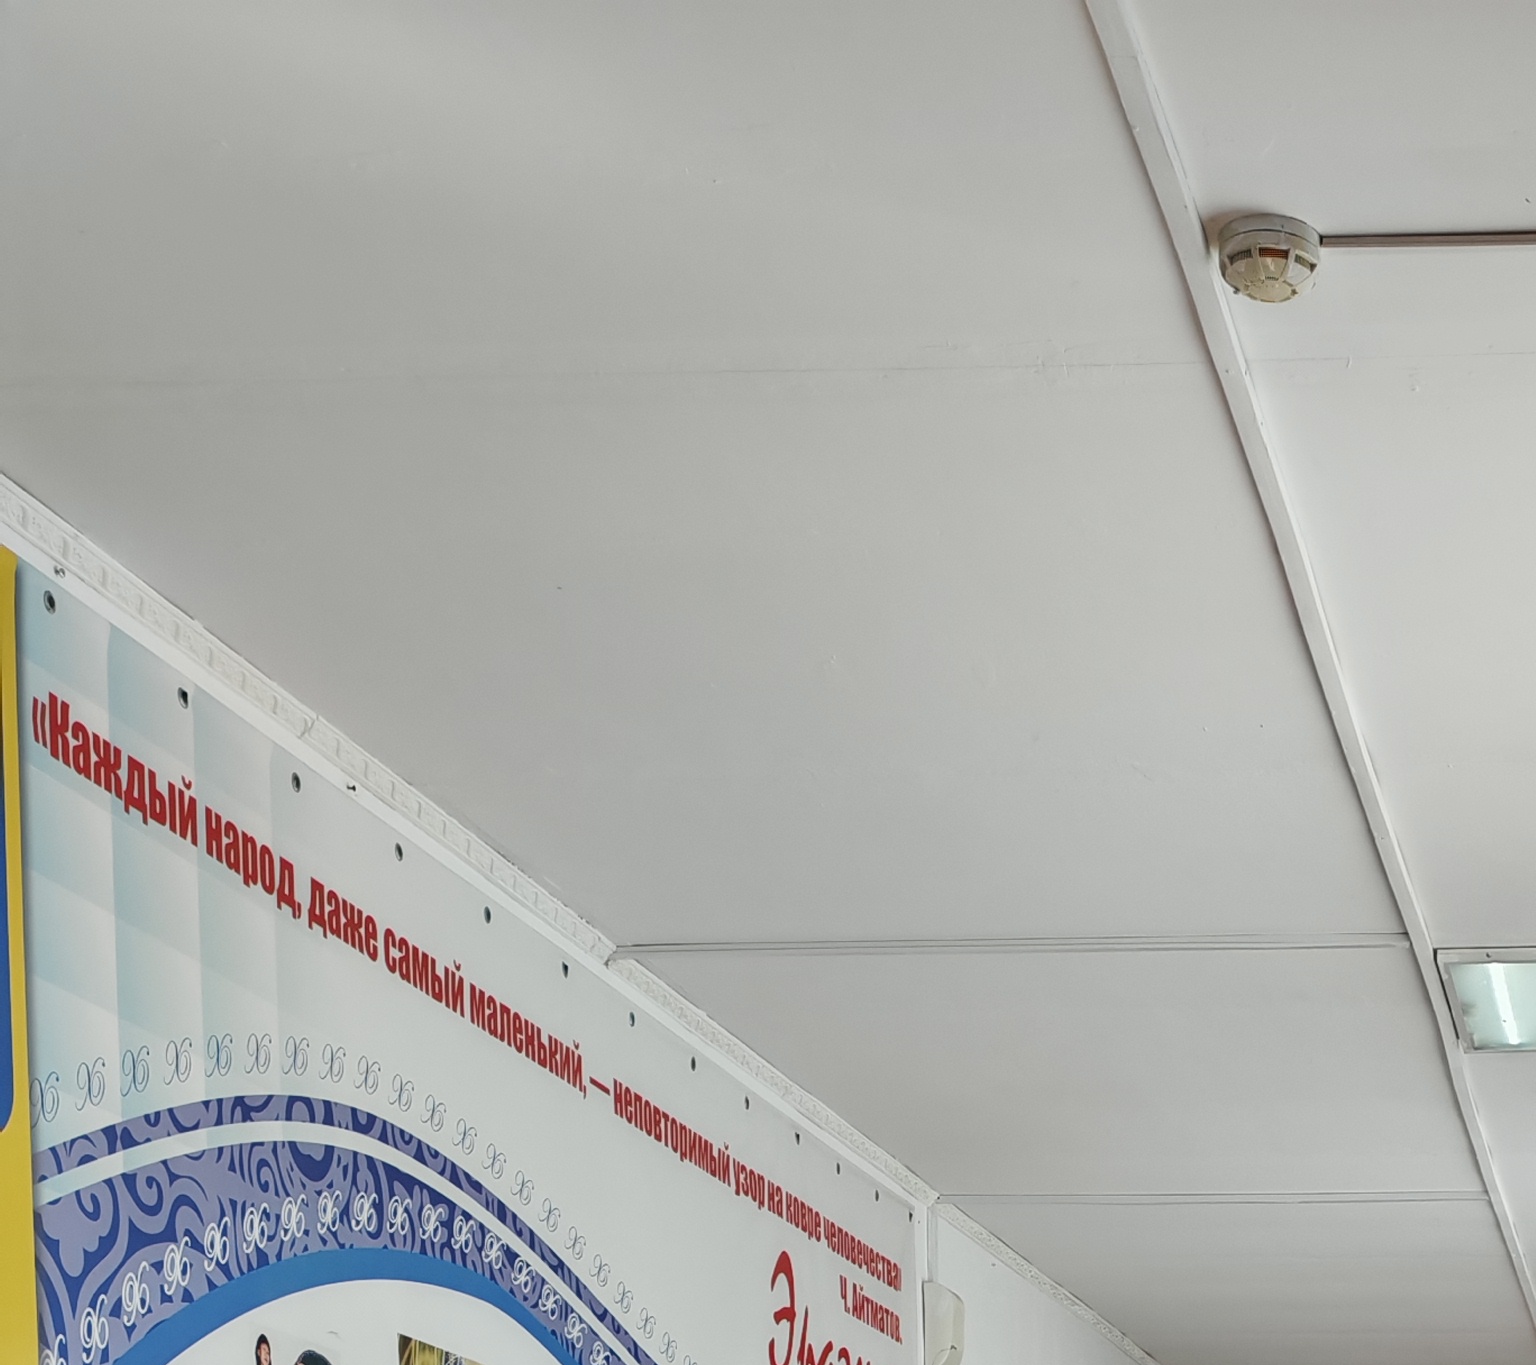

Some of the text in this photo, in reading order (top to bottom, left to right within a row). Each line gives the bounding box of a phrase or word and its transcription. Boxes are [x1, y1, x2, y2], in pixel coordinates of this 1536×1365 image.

[32, 690, 198, 848] «Каждый
[204, 805, 303, 920] народ,
[307, 876, 379, 963] даже
[383, 927, 466, 1019] самый
[469, 981, 588, 1101] маленький,
[613, 1076, 732, 1188] неповторимый
[732, 1156, 766, 1211] узор
[767, 1178, 784, 1219] на
[785, 1190, 822, 1242] ковре
[839, 1273, 851, 1315] Ч.
